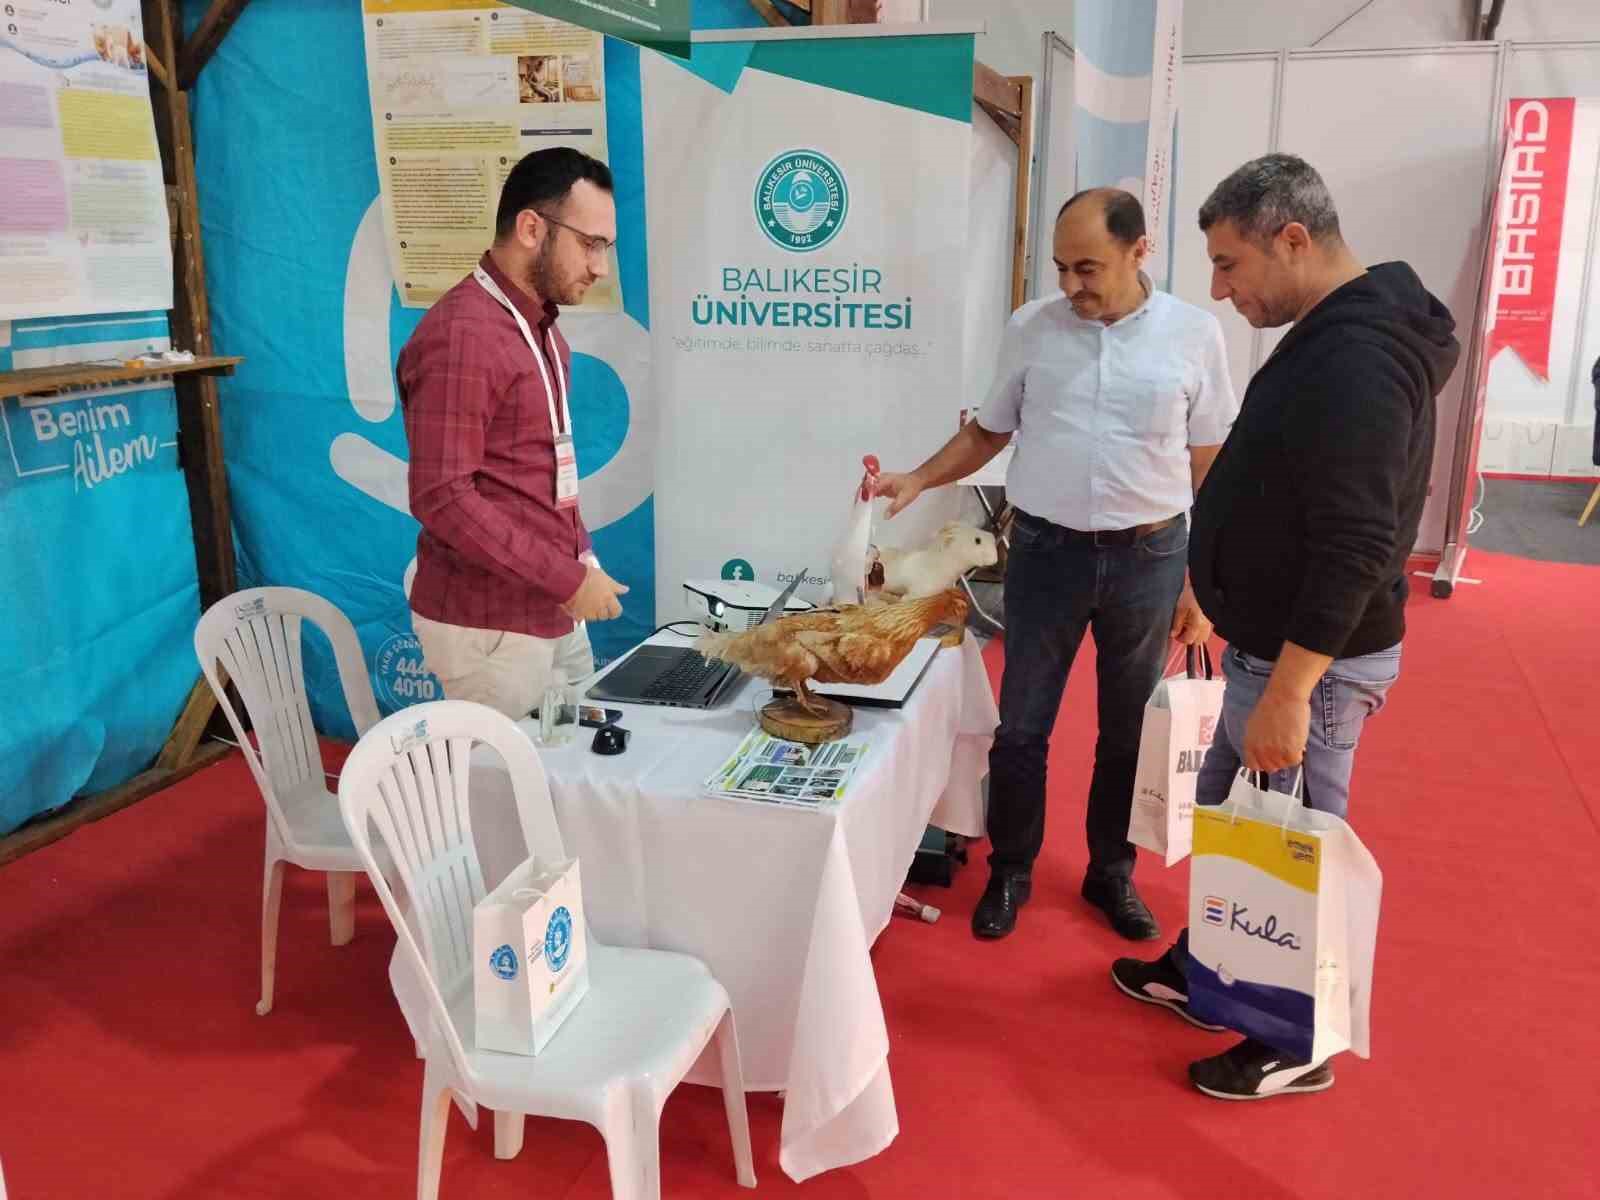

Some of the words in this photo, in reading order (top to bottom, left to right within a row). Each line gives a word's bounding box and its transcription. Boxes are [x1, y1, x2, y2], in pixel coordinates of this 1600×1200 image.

[722, 263, 881, 293] BALIKESİR
[692, 294, 912, 329] ÜNİVERSİTESİ
[31, 400, 131, 441] Benim
[73, 432, 157, 494] Ailem
[1231, 902, 1301, 951] Kula
